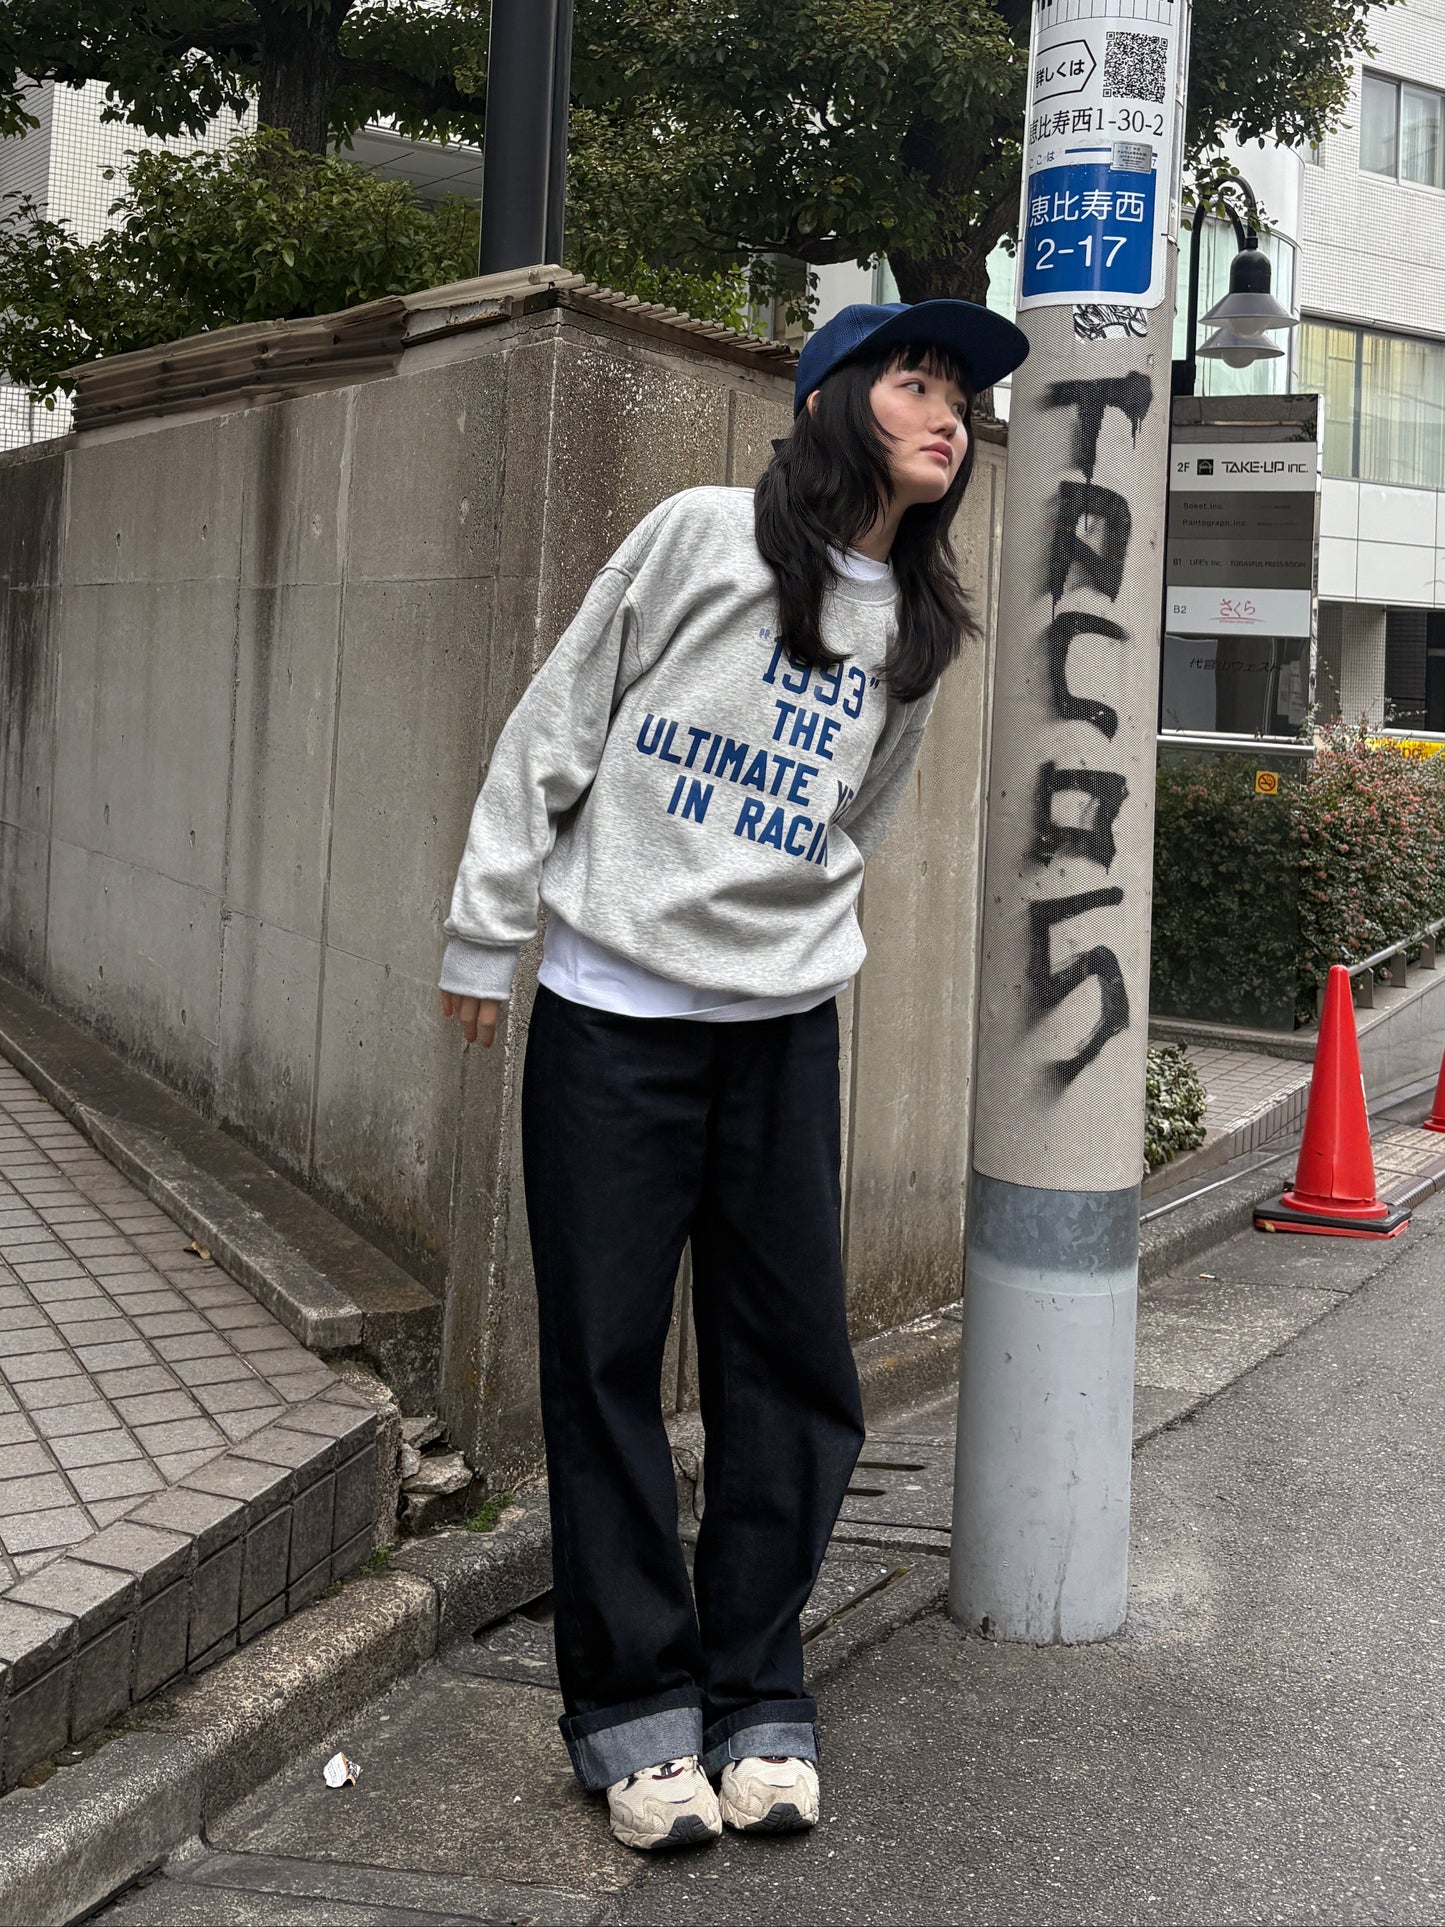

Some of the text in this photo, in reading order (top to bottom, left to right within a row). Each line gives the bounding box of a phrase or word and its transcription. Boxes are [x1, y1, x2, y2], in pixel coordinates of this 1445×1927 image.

[1035, 59, 1086, 89] 詳しくは
[1029, 188, 1146, 228] 恵比寿西
[1035, 234, 1128, 271] 2-17
[1177, 462, 1190, 473] 2F
[1173, 605, 1187, 614] B2
[1220, 598, 1256, 618] さくら
[772, 699, 841, 761] THE
[635, 713, 819, 807] ULTIMATE
[667, 774, 715, 825] IN
